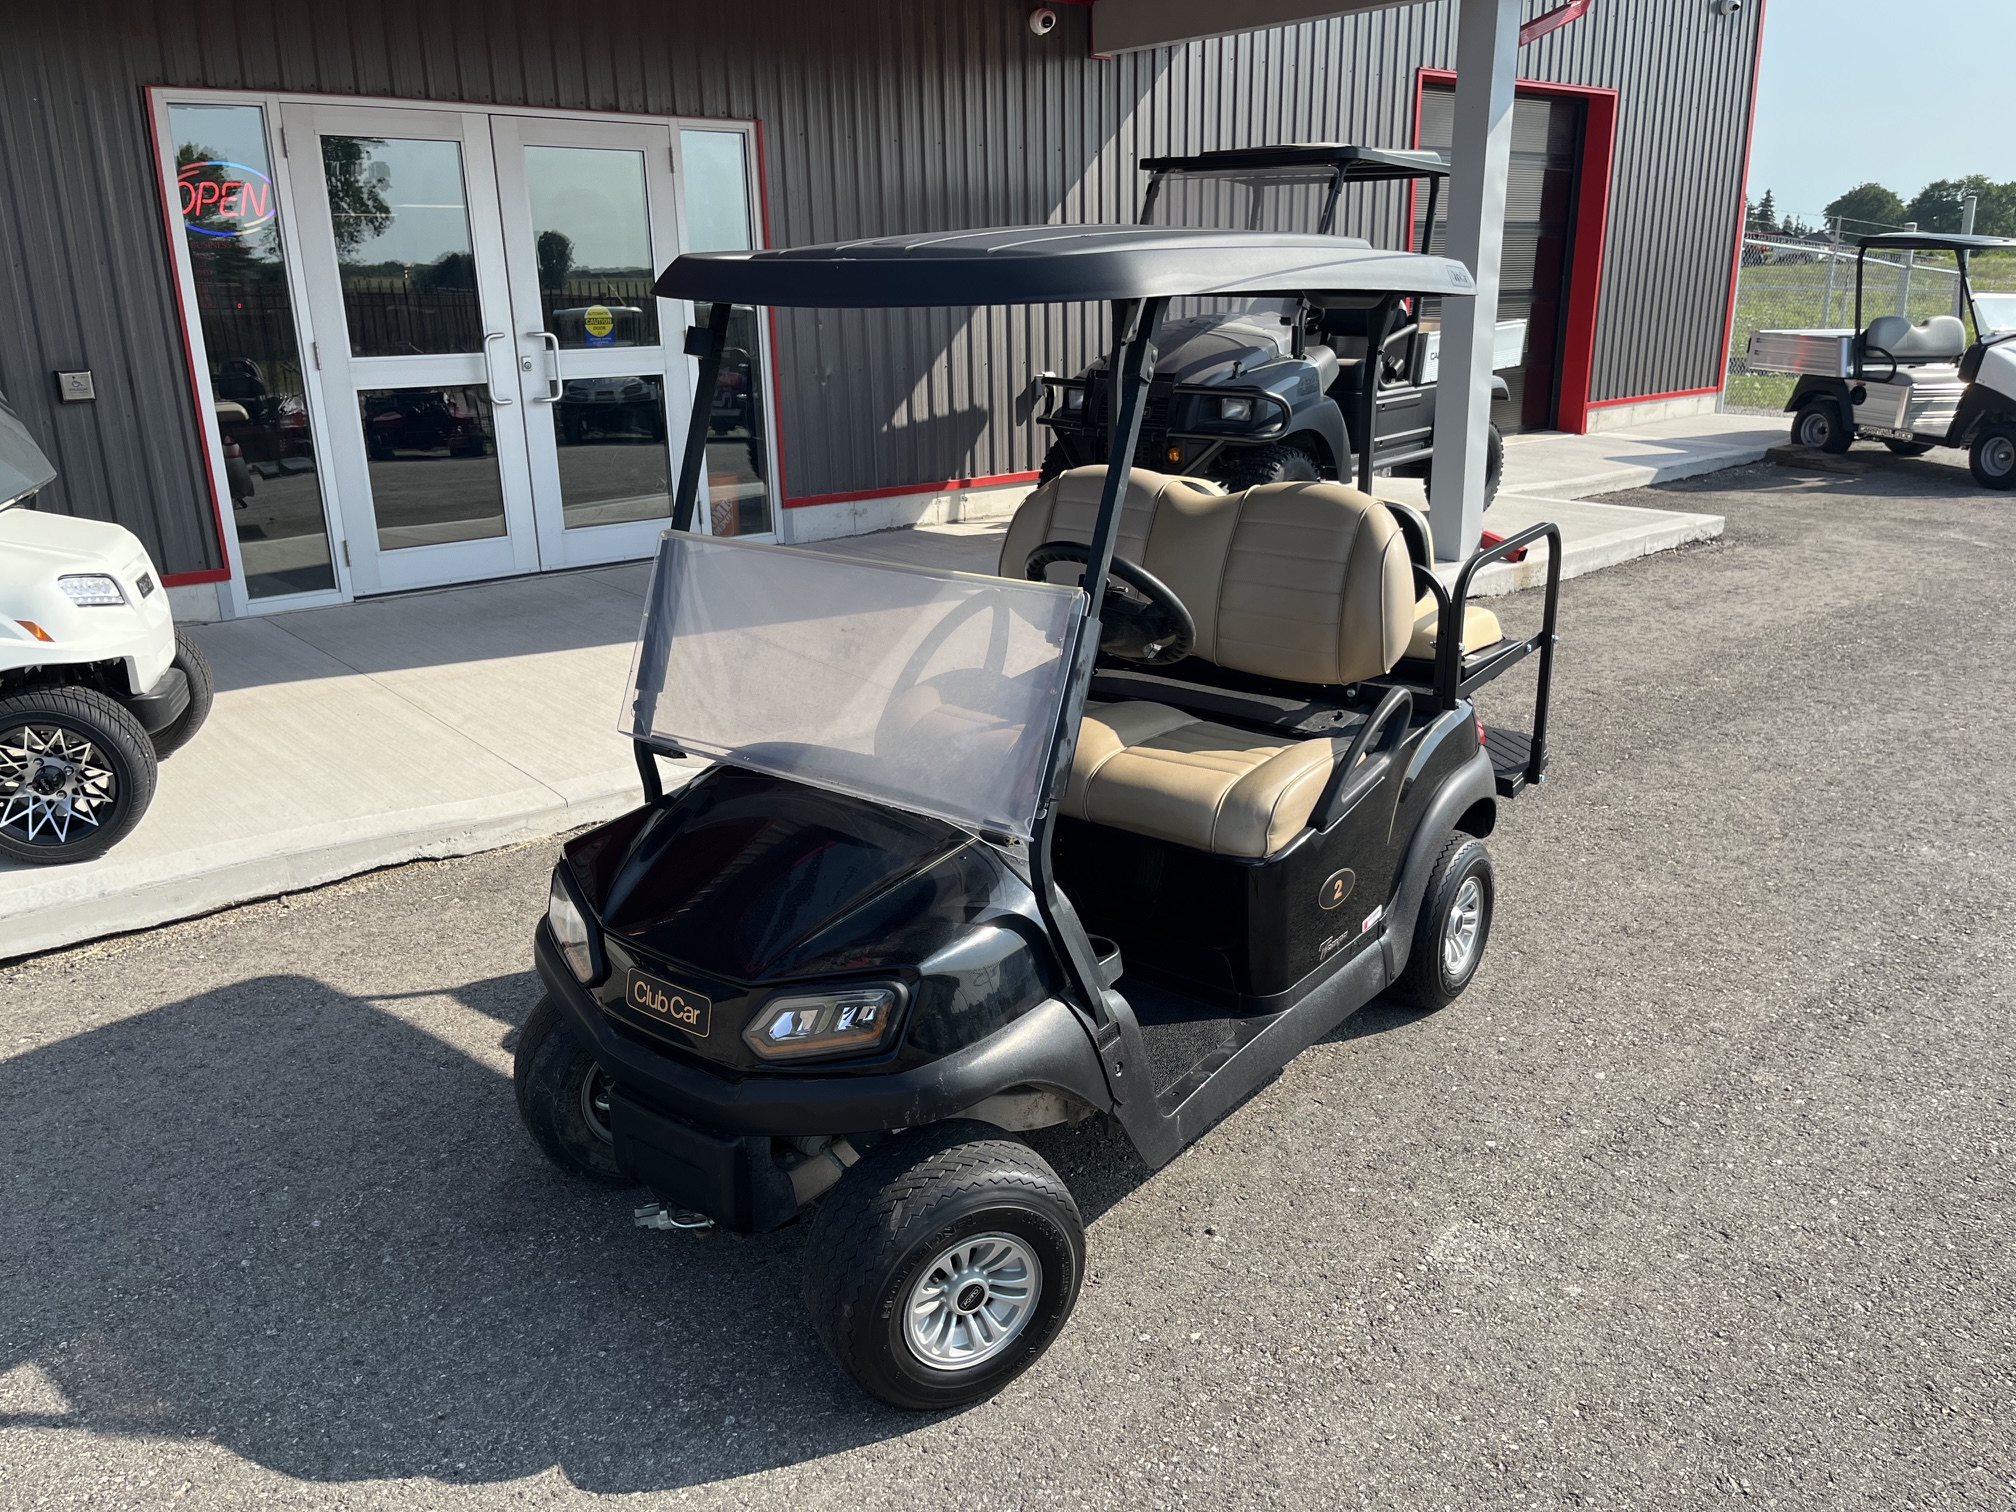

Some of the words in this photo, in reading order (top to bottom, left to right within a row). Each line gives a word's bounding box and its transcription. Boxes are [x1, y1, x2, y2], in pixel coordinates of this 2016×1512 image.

[178, 181, 268, 217] OPEN
[1895, 431, 1913, 441] 300
[1334, 879, 1343, 901] 2
[634, 980, 669, 1013] Club
[670, 996, 701, 1025] Car
